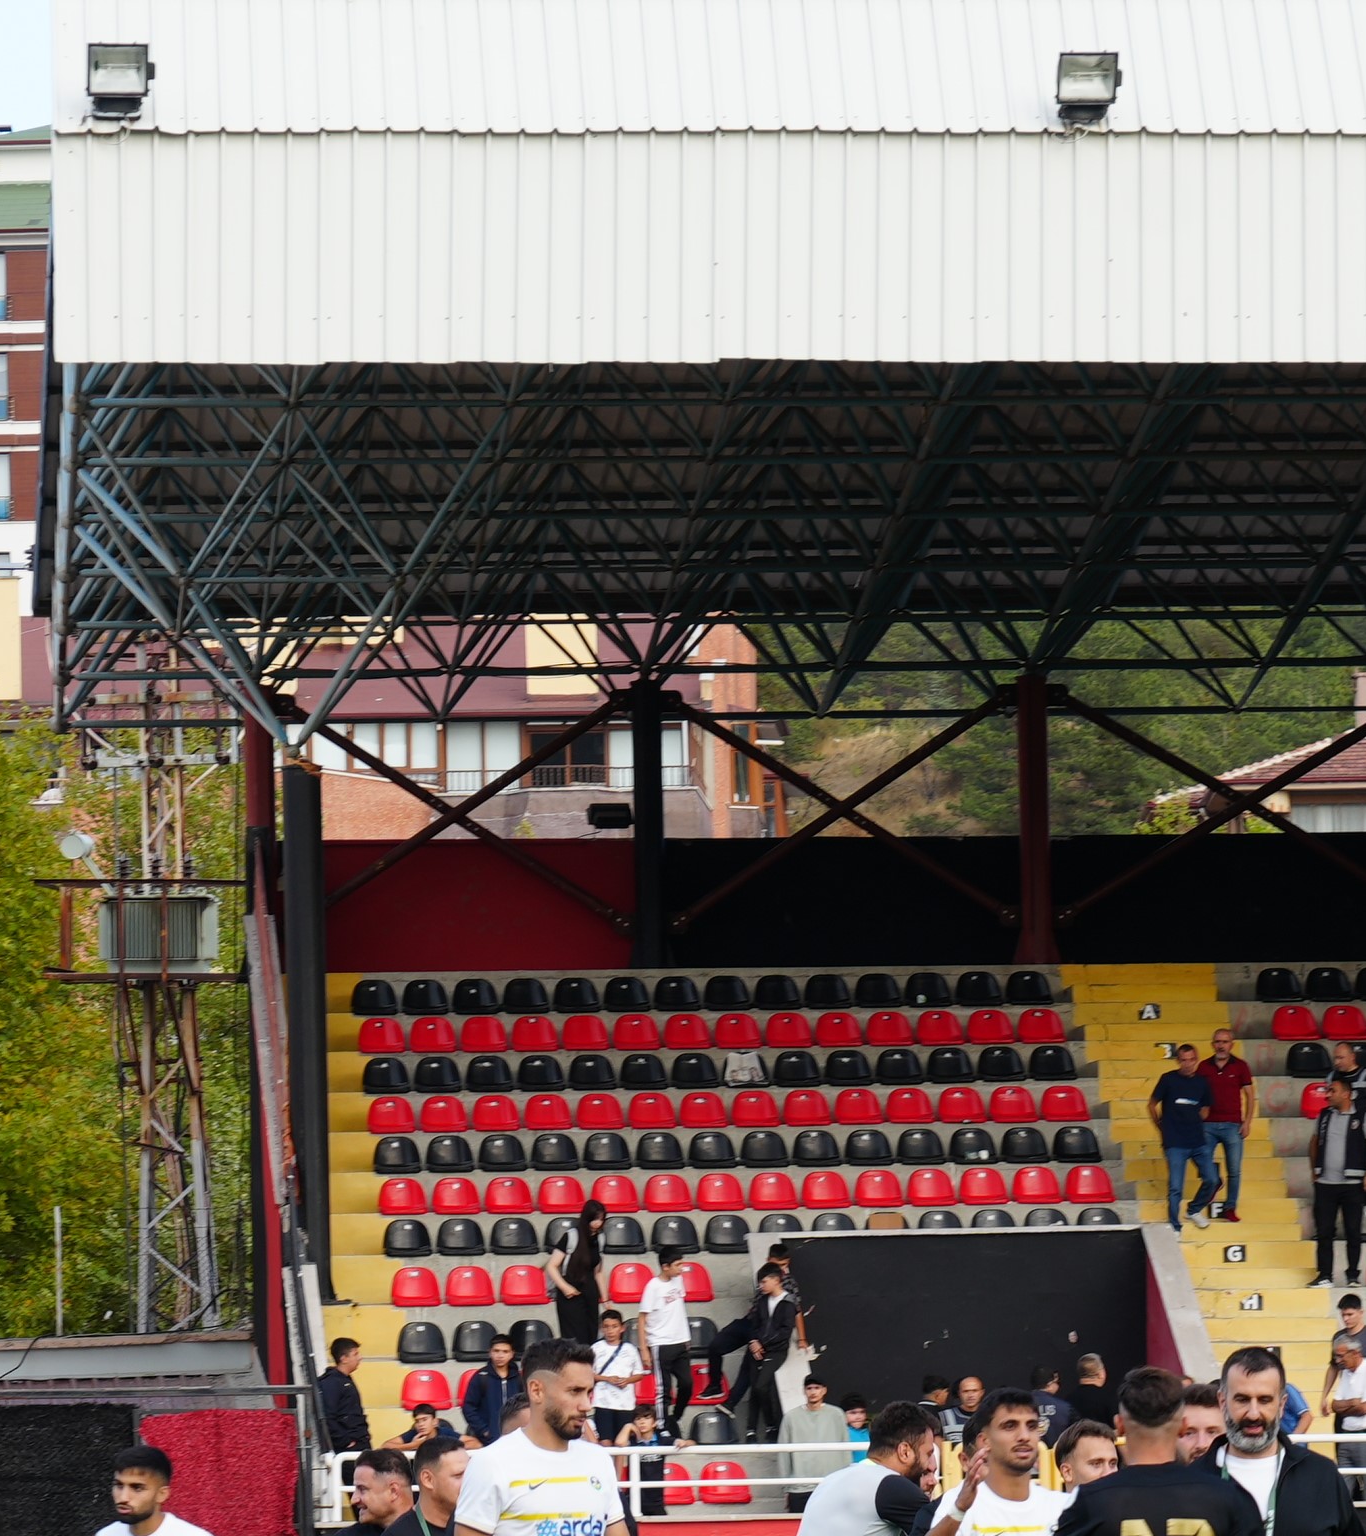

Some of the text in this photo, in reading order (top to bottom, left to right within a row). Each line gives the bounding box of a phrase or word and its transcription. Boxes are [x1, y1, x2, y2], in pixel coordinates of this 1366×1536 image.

[1141, 1004, 1157, 1019] A
[1210, 1202, 1223, 1218] F
[1226, 1245, 1243, 1262] G
